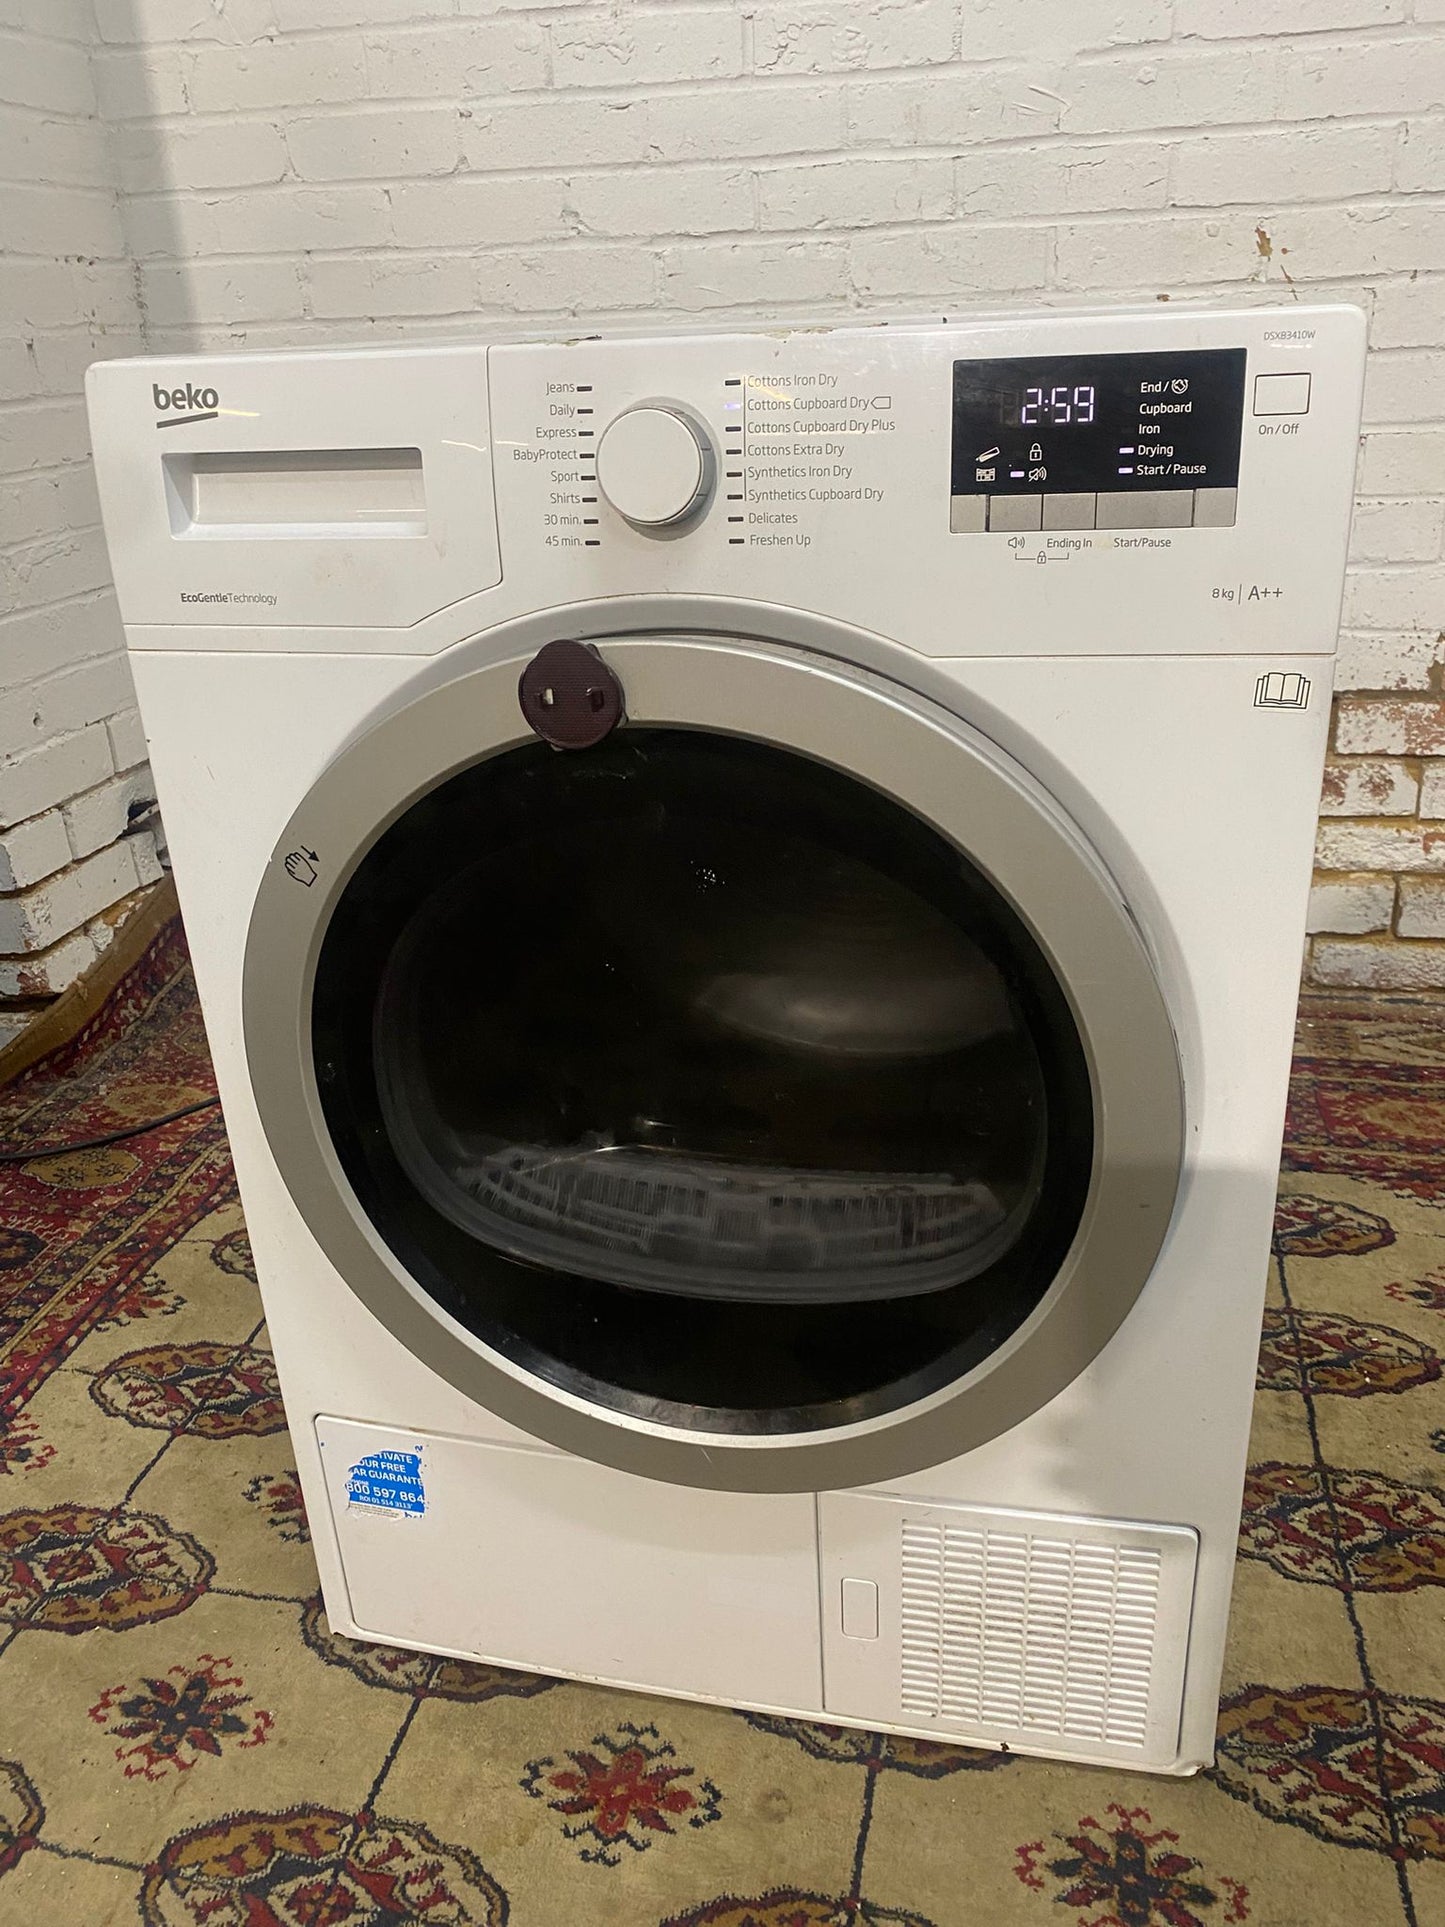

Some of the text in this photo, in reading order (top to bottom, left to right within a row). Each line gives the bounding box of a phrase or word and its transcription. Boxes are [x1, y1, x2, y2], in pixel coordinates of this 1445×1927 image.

[747, 373, 838, 387] Cottons Iron Dry
[546, 382, 575, 395] Jeans
[1140, 382, 1163, 393] End
[152, 383, 219, 410] beko
[747, 396, 870, 412] Cottons Cupboard Dry
[1021, 386, 1095, 424] 2:59
[1139, 401, 1192, 415] Cupboard
[550, 404, 575, 418] Daily
[536, 427, 577, 439] Express
[747, 419, 895, 434] Cottons Cupboard Dry Plus
[1138, 424, 1161, 434] Iron
[513, 449, 577, 462] BabyProtect
[747, 443, 845, 457] Cottons Extra Dry
[1137, 444, 1174, 457] Drying
[551, 471, 579, 483] Sport
[748, 465, 853, 481] Synthetics Iron Dry
[550, 493, 581, 504] Shirts
[749, 487, 884, 503] Synthetics Cupboard Dry
[544, 514, 581, 525] 30 min.
[749, 512, 798, 524] Delicates
[545, 536, 583, 546] 45 min.
[750, 534, 811, 547] Freshen Up
[1046, 538, 1092, 551] Ending In
[1113, 537, 1172, 548] Start/Pause
[1212, 585, 1283, 601] 8 kg A++
[373, 1453, 413, 1464] TIVATE
[380, 1461, 406, 1473] FREE
[373, 1486, 396, 1499] 597
